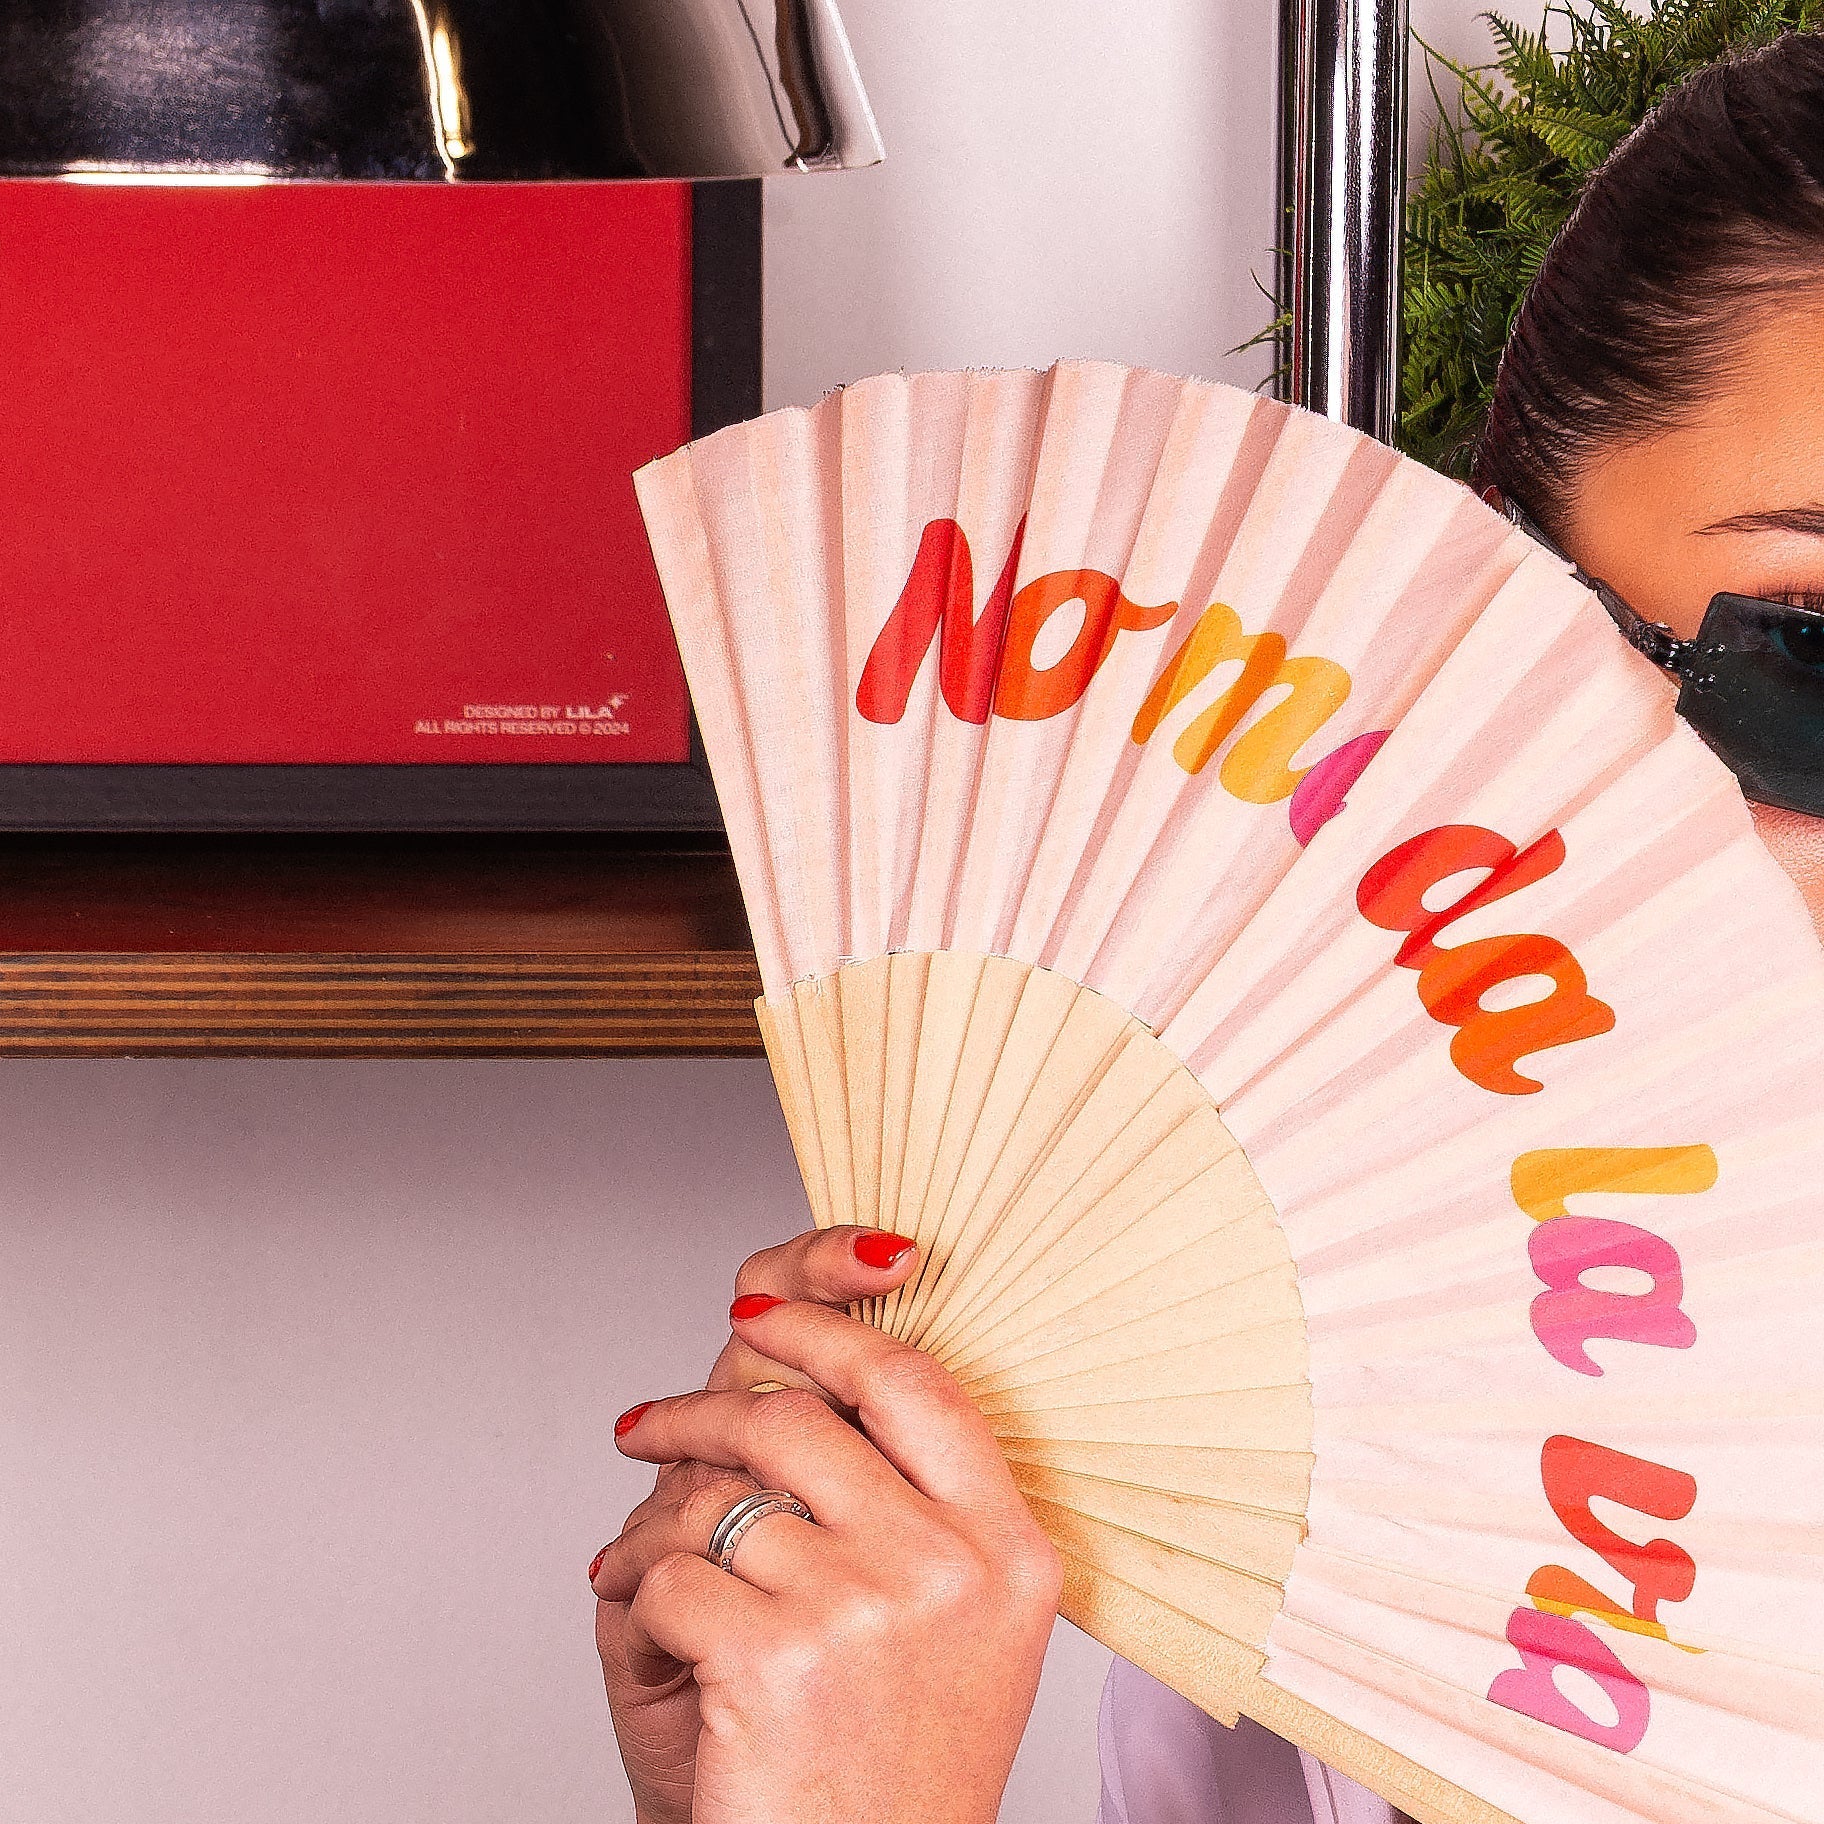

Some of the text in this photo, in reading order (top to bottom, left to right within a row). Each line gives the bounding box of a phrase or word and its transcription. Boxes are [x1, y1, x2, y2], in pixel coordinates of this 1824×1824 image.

[462, 704, 538, 719] DESIGNED
[540, 704, 561, 719] BY
[413, 719, 442, 735] ALL
[443, 719, 498, 735] RIGHTS
[499, 719, 575, 735] RESERVED
[592, 720, 630, 735] 2024
[855, 510, 1178, 725] No
[1355, 823, 1617, 1096] da
[1510, 1143, 1719, 1377] la
